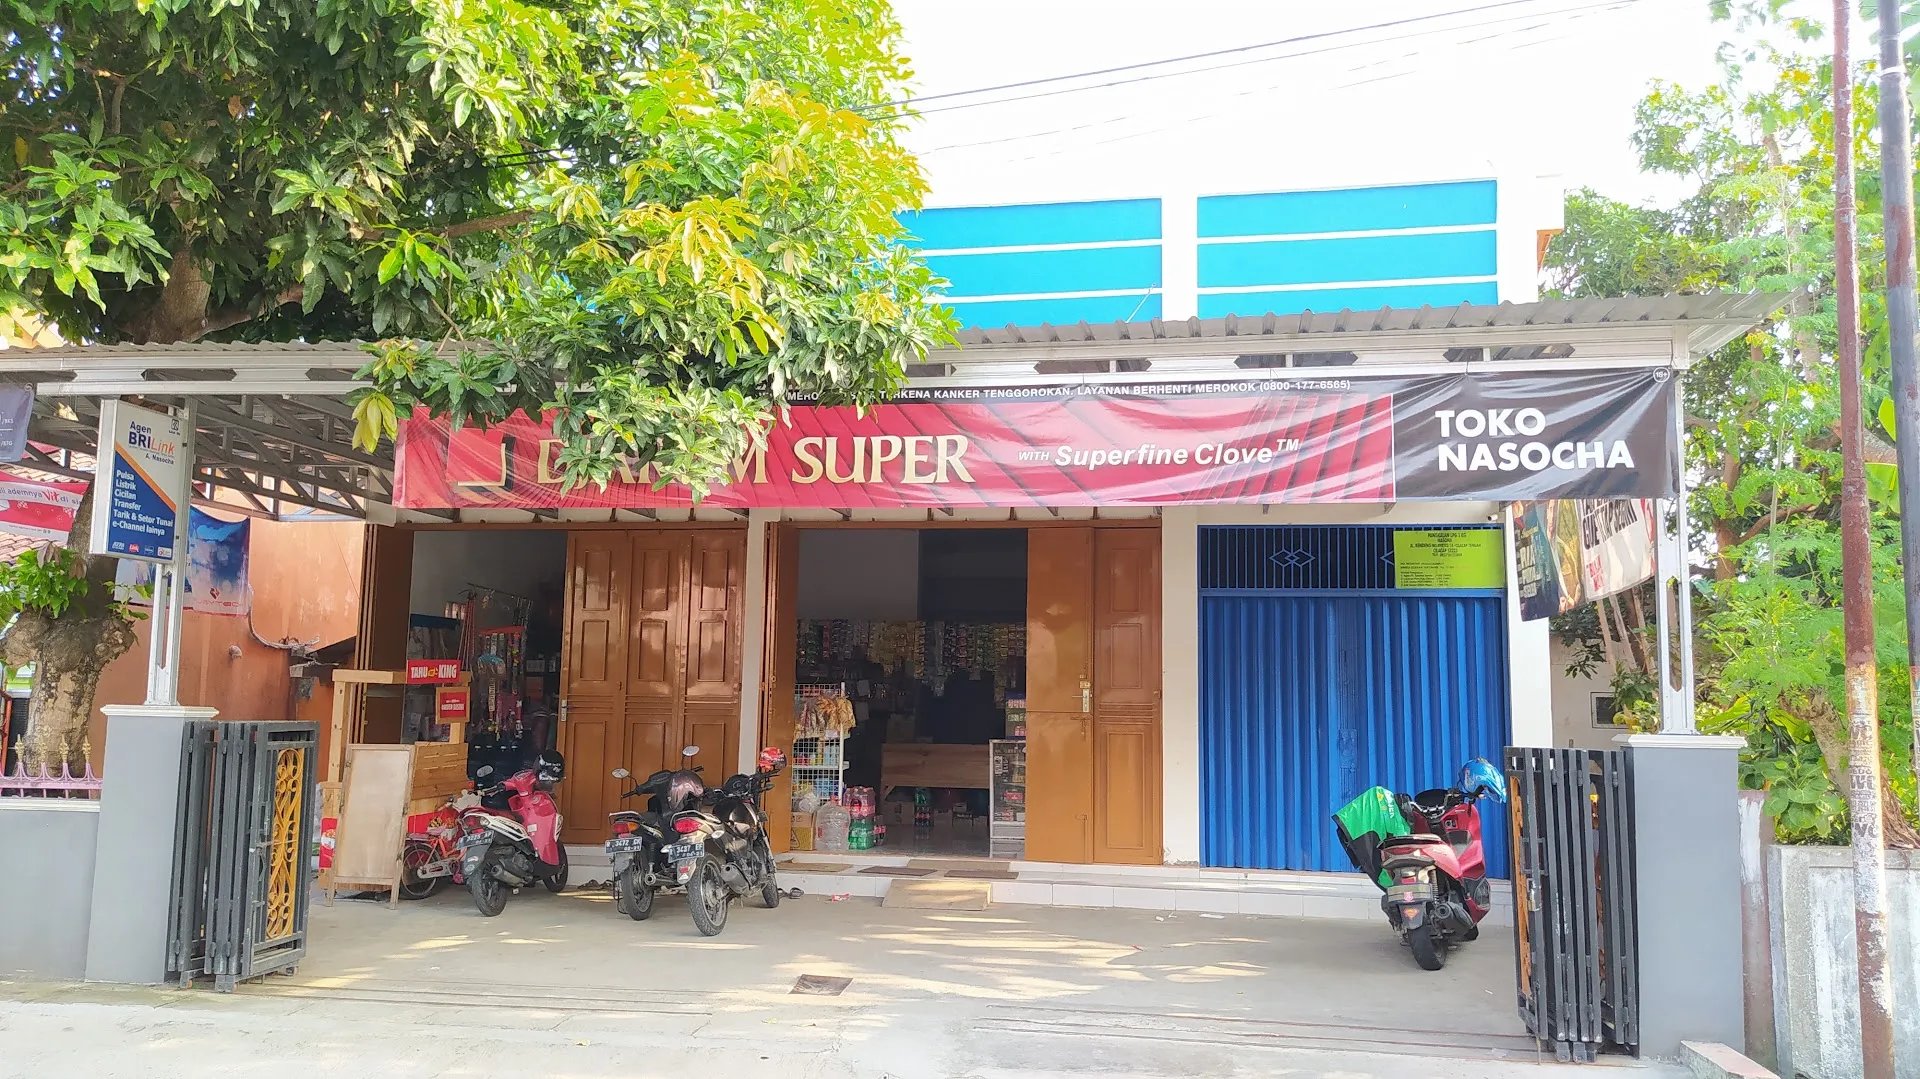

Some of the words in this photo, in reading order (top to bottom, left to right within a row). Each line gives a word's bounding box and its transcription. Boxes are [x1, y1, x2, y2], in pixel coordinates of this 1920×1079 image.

[934, 389, 980, 399] KANKER
[984, 387, 1073, 398] TENGGOROKAN.
[1077, 386, 1130, 396] LAYANAN
[1133, 384, 1192, 395] BERHENTI
[1195, 382, 1256, 393] MEROKOK
[1259, 380, 1351, 393] (0800-177-6565)
[129, 420, 152, 435] Agen
[1435, 407, 1546, 438] TOKO
[128, 431, 176, 455] BRILink
[152, 453, 175, 465] Nasocha
[791, 434, 977, 484] SUPER
[1018, 451, 1049, 461] WITH
[1055, 444, 1188, 470] Superfine
[1438, 439, 1635, 471] NASOCHA
[116, 469, 135, 481] Pulsa
[115, 479, 137, 491] Listrik
[7, 488, 43, 500] ademnya
[42, 489, 60, 502] Vit
[60, 495, 69, 503] di
[114, 488, 137, 501] Cicilan
[114, 498, 142, 511] Transfer
[113, 508, 131, 520] Tarik
[131, 512, 137, 521] &
[138, 513, 156, 524] Setor
[156, 516, 173, 527] Tunai
[112, 520, 146, 533] e-Channel
[146, 524, 165, 537] lainya
[411, 666, 429, 679] TAHU
[438, 664, 457, 679] KING
